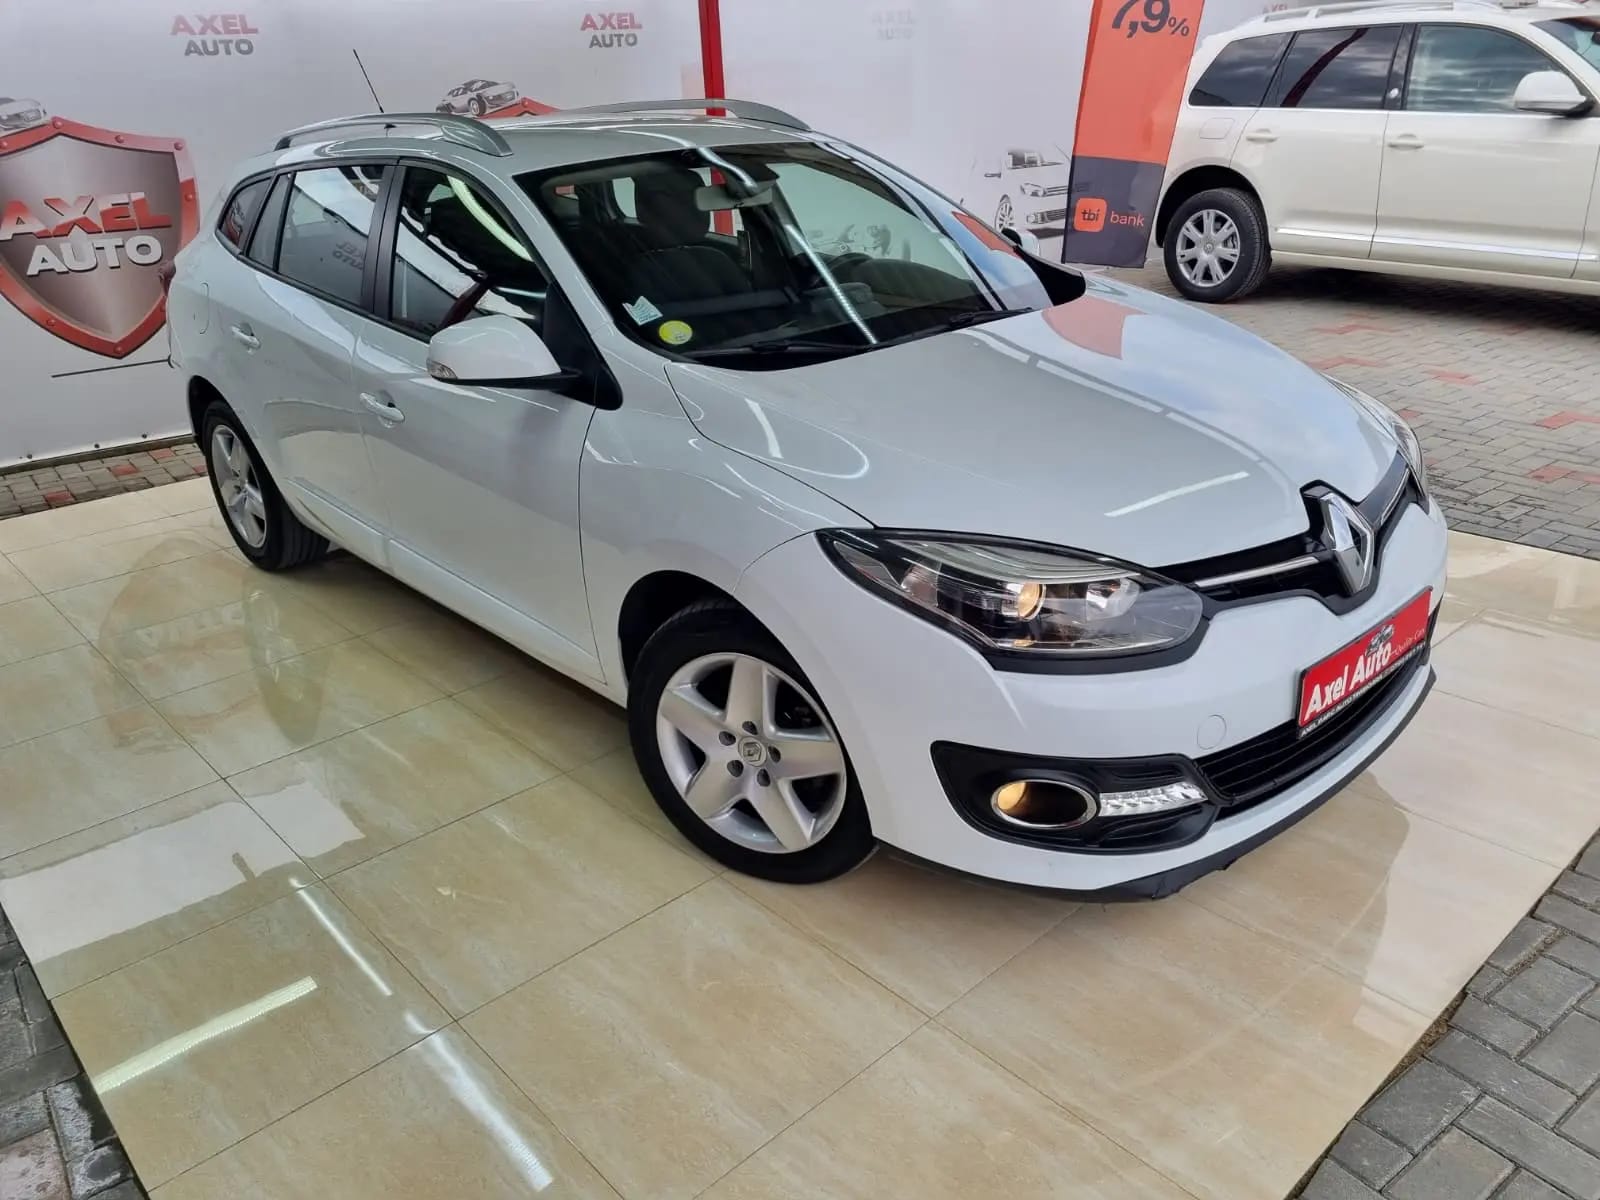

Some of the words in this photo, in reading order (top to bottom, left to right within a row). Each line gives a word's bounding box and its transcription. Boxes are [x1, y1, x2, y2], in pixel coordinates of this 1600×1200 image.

[170, 14, 258, 36] AXEL
[580, 13, 642, 31] AXEL
[184, 38, 254, 56] AUTO
[589, 33, 637, 48] AUTO
[0, 191, 172, 240] AXEL
[1081, 208, 1100, 222] tbi
[1110, 211, 1144, 227] bank
[26, 235, 162, 276] AUTO
[1303, 664, 1349, 721] Axel
[1349, 642, 1391, 690] Auto
